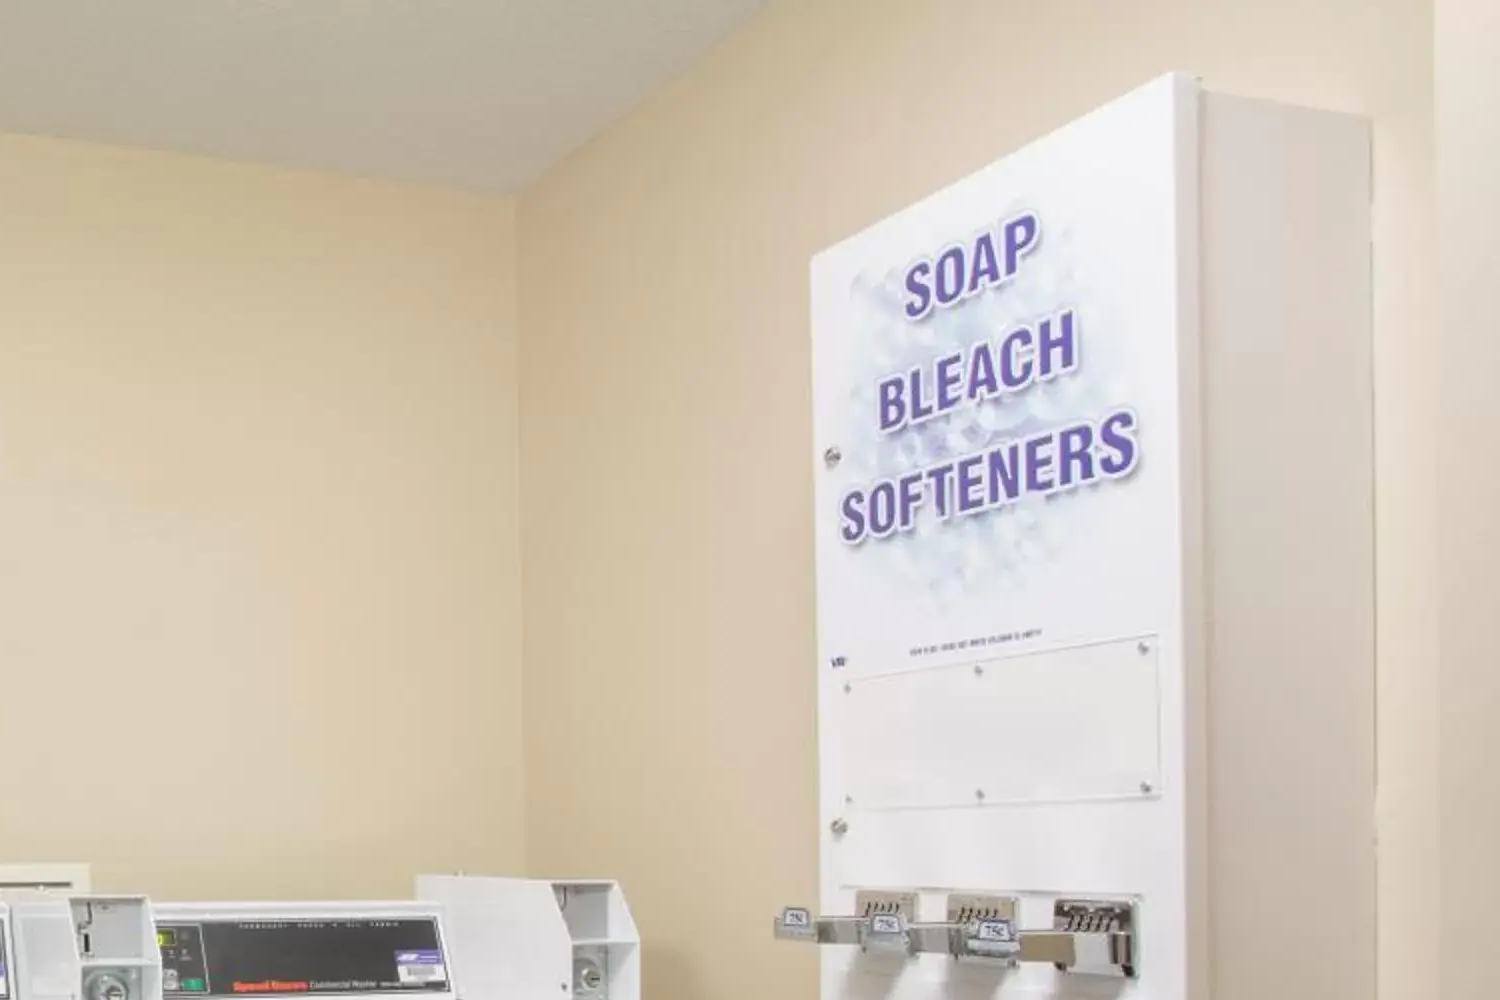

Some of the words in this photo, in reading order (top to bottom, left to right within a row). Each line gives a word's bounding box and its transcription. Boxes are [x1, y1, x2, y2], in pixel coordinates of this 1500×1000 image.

[904, 213, 1038, 318] SOAP
[877, 309, 1075, 431] BLEACH
[841, 411, 1136, 542] SOFTENERS
